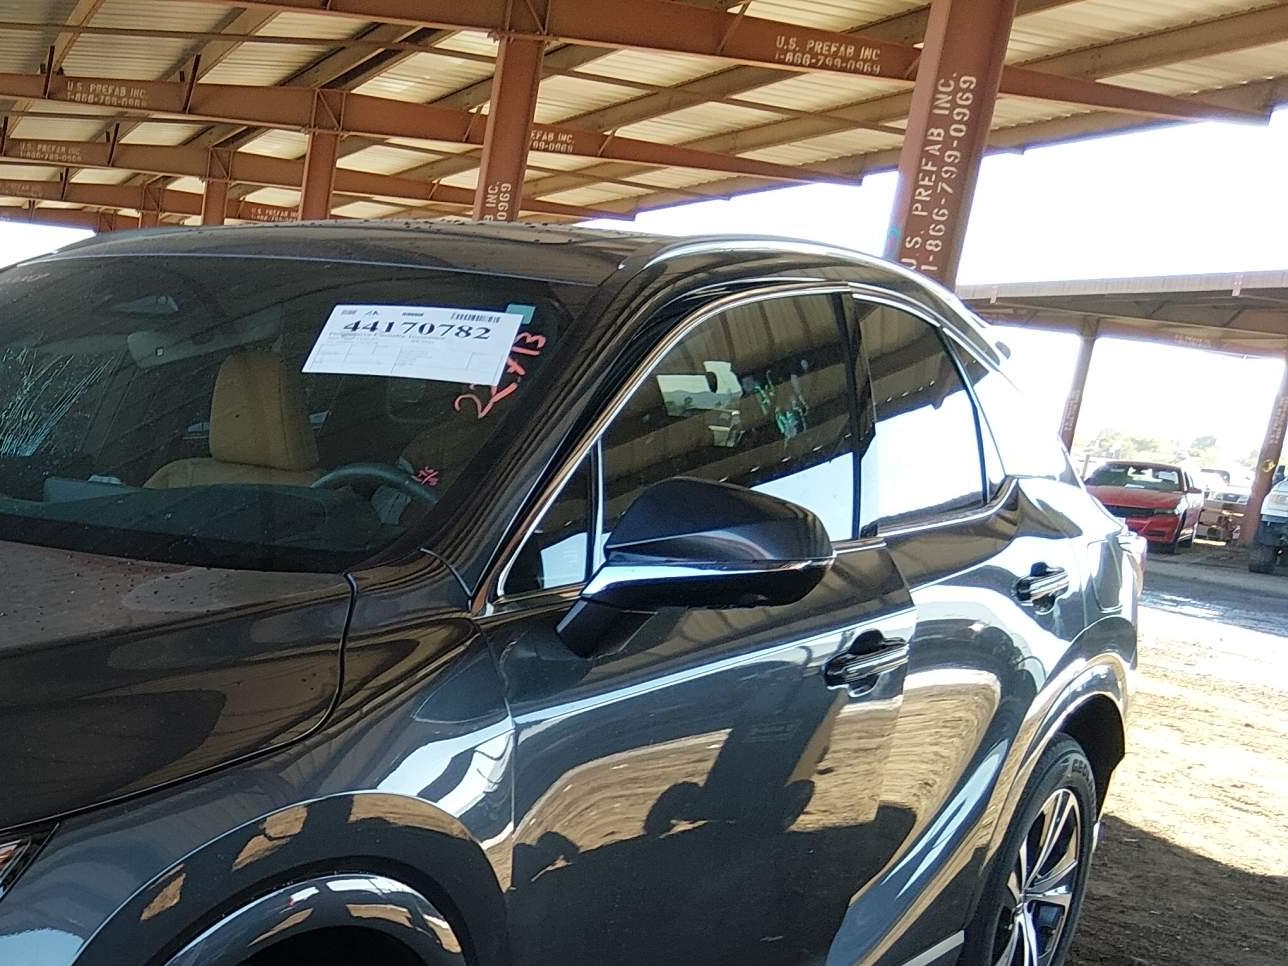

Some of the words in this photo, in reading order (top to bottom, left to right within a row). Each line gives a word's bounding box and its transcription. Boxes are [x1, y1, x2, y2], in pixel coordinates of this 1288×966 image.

[775, 35, 800, 51] U.S.
[806, 40, 856, 57] PREFAB
[859, 46, 881, 61] INC
[89, 83, 127, 97] PREFAB
[912, 127, 945, 216] PREFAB
[932, 72, 958, 115] INC.
[920, 75, 977, 271] 1-866-799-0969
[343, 319, 491, 340] 44170782
